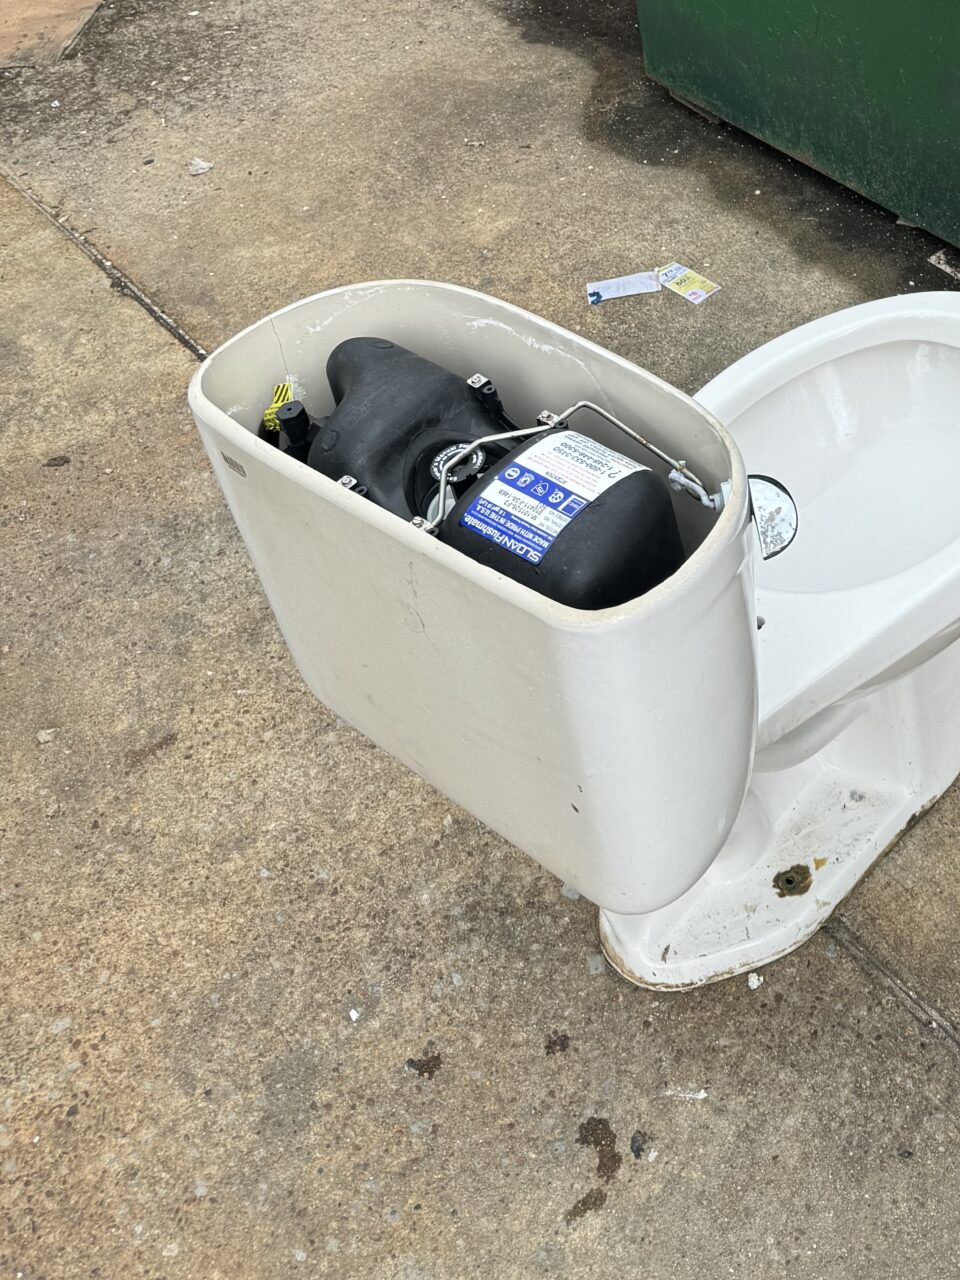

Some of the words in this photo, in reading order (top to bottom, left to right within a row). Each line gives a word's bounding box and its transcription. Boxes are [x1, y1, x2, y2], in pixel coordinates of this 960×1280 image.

[488, 510, 500, 521] THE
[498, 516, 507, 525] IN
[504, 519, 522, 533] PRIDE
[519, 527, 534, 540] WITH
[531, 534, 549, 548] MADE
